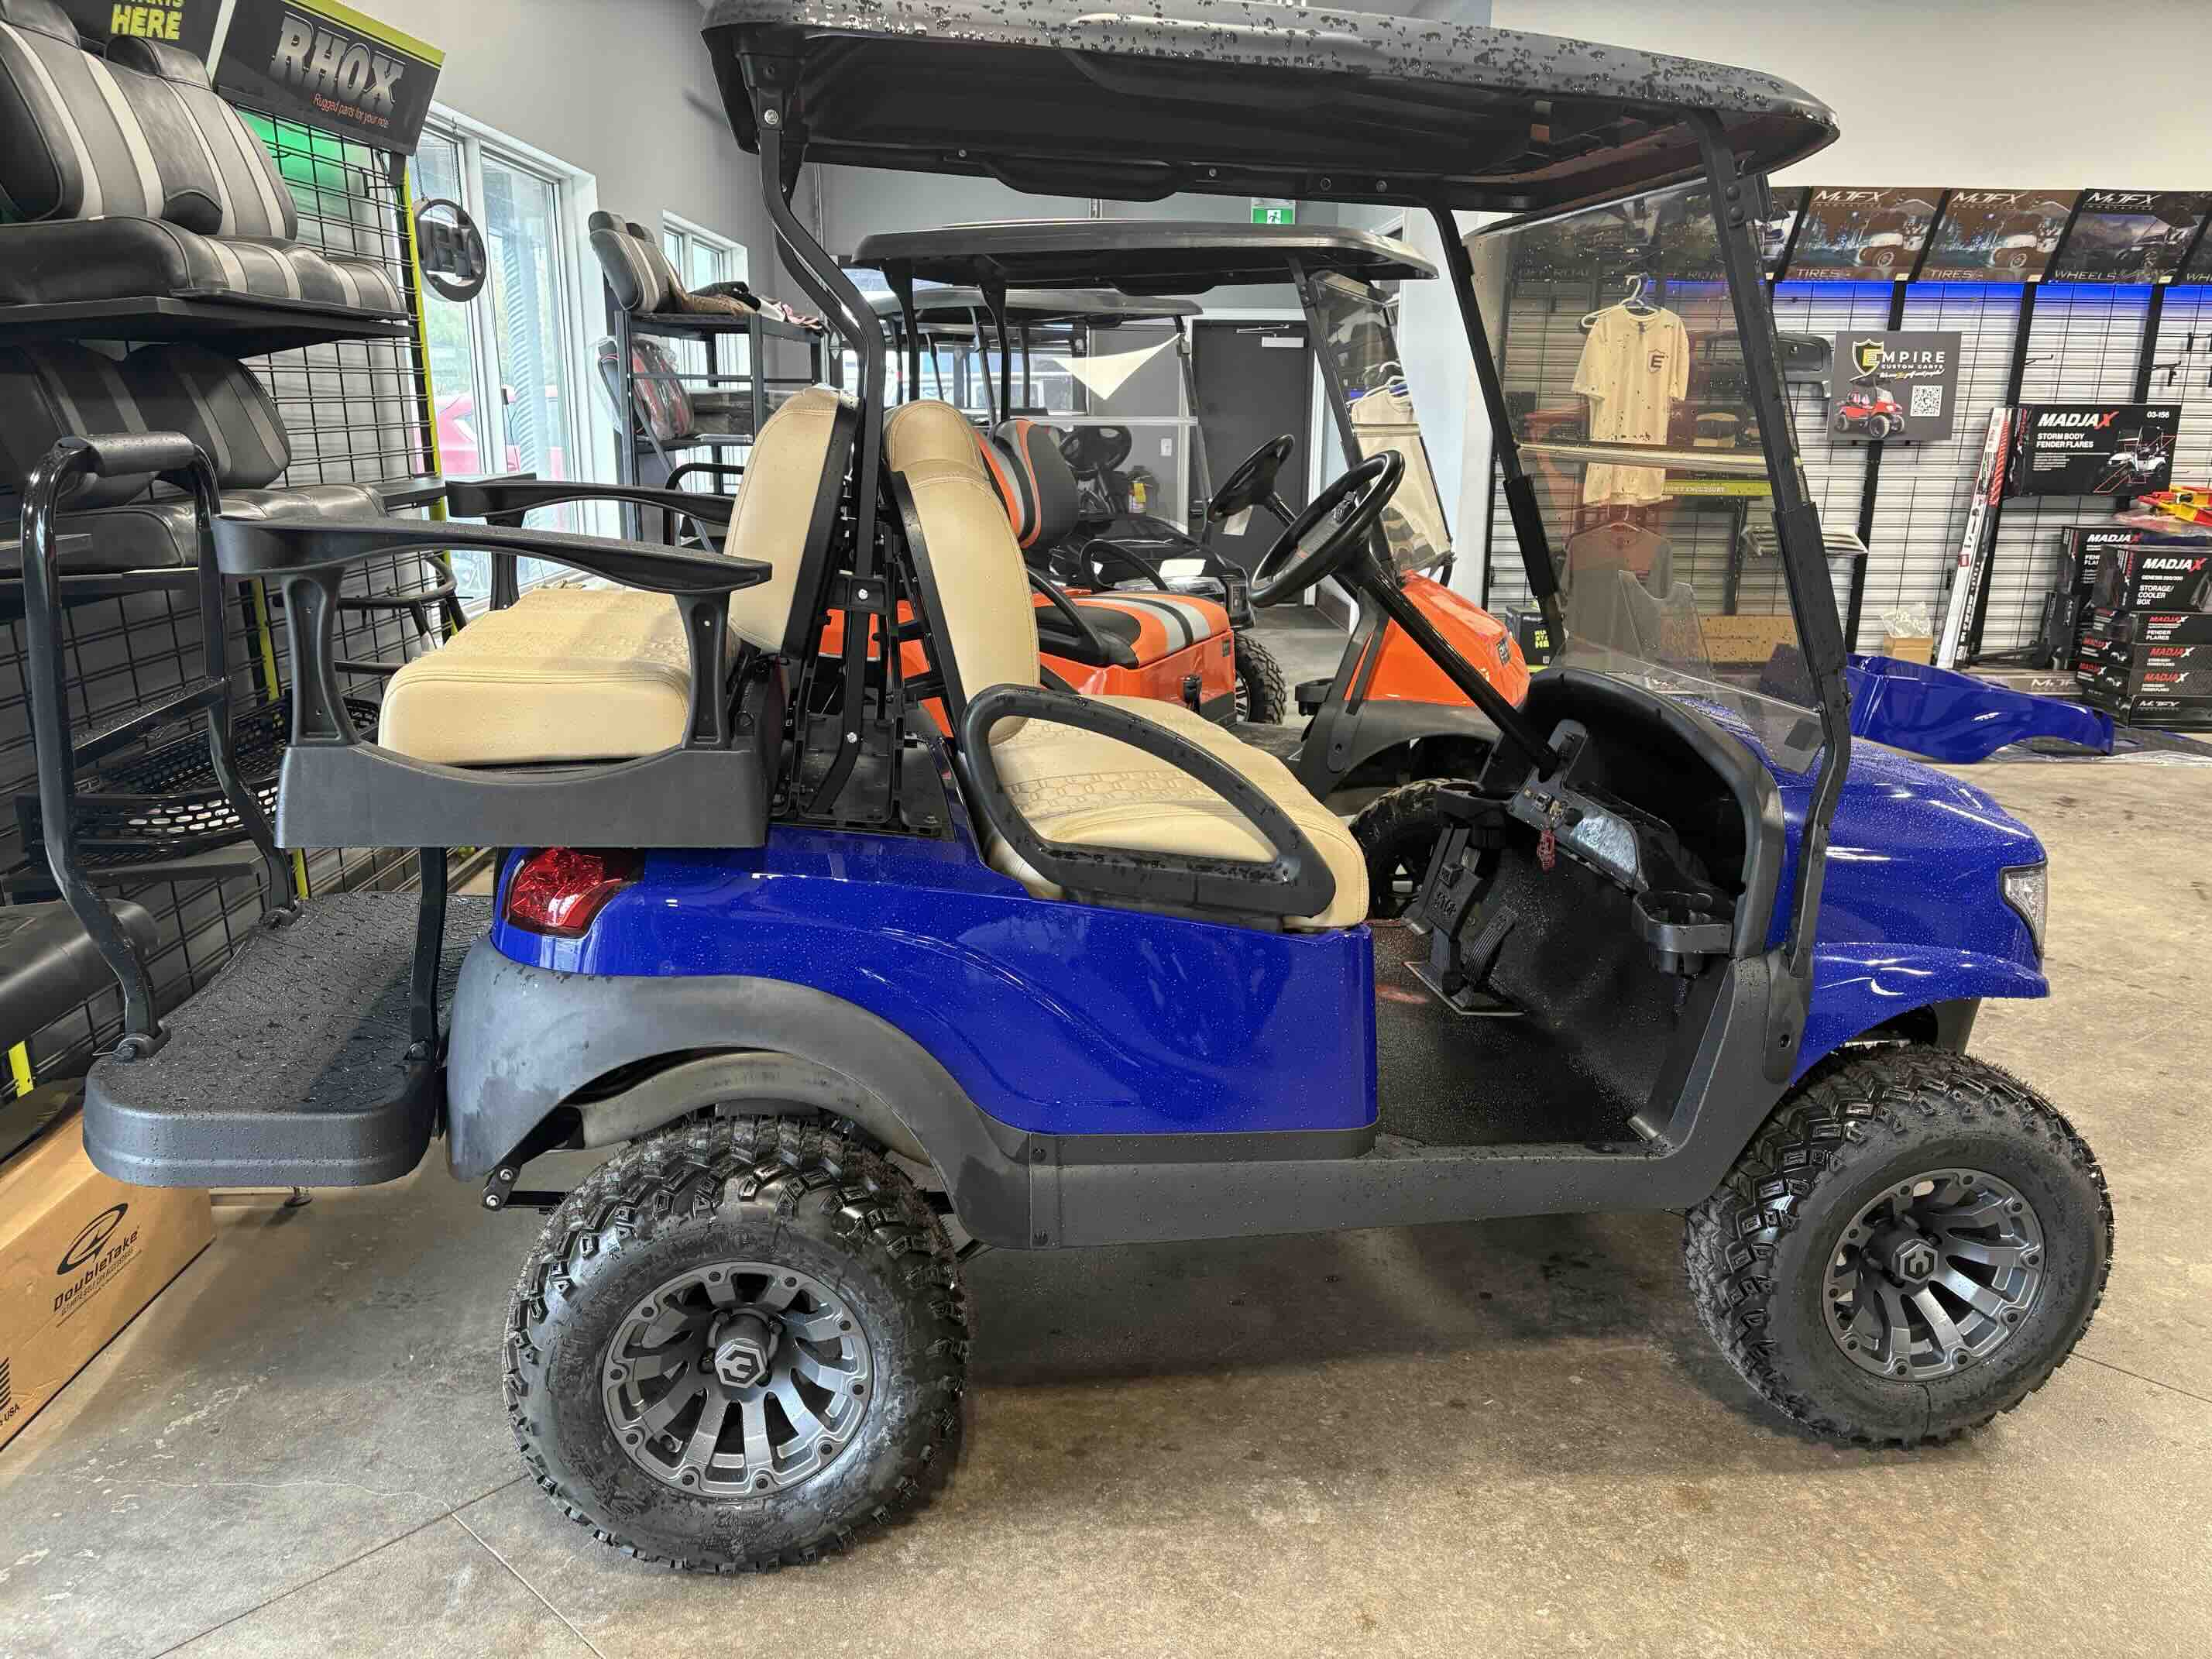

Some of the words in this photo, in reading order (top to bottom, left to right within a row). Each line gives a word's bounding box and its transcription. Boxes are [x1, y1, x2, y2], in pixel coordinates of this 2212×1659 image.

[111, 3, 182, 40] HERE
[270, 11, 407, 111] RHOX
[314, 92, 340, 112] Rugged
[1797, 268, 1840, 278] TIRES
[1932, 269, 1973, 279] TIRES
[2054, 270, 2117, 280] WHEELS
[2038, 410, 2120, 430] MADJAX
[2087, 533, 2143, 544] MADJAX
[2142, 558, 2207, 572] MADJAX
[2149, 647, 2195, 658] MADJAX
[2143, 672, 2190, 682] MADJAX
[54, 1231, 138, 1311] DoubleTake
[5, 1403, 20, 1420] USA
